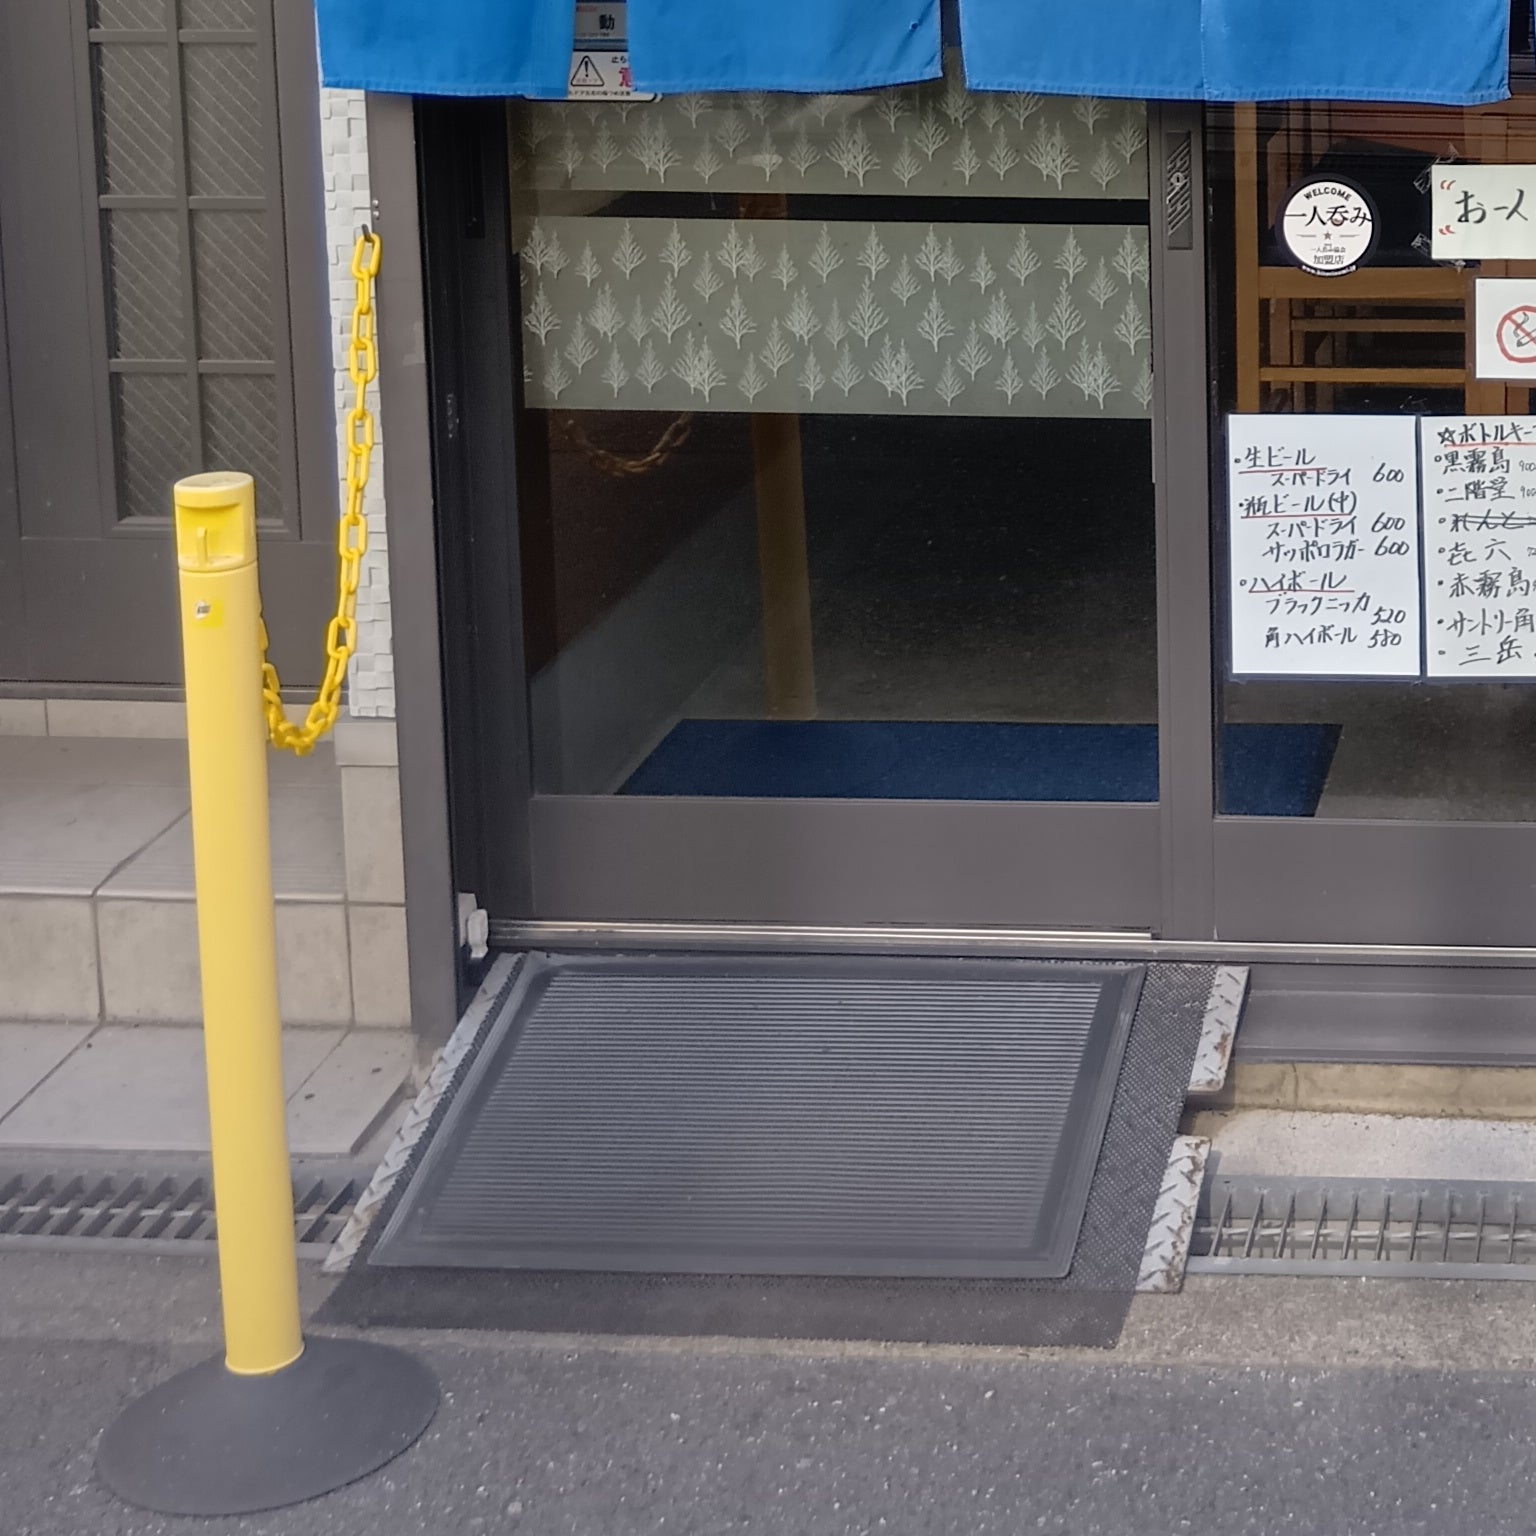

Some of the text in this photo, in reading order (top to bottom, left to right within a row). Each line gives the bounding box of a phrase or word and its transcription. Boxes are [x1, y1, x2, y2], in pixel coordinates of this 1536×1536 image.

[1303, 187, 1352, 202] WELCOME
[1285, 205, 1372, 227] 一人呑み
[1244, 445, 1317, 469] 生ビール
[1443, 446, 1511, 474] 黒霧島
[1372, 462, 1404, 483] 600
[1444, 476, 1515, 502] 二階堂
[1371, 512, 1406, 532] 600
[1262, 536, 1409, 562] サッポロラガー 600
[1249, 570, 1347, 592] ハイボール
[1448, 567, 1530, 598] 赤霧島
[1265, 591, 1371, 616] ブラックニッカ
[1265, 624, 1402, 648] 角ハイボール 580
[1459, 635, 1523, 665] 三岳
